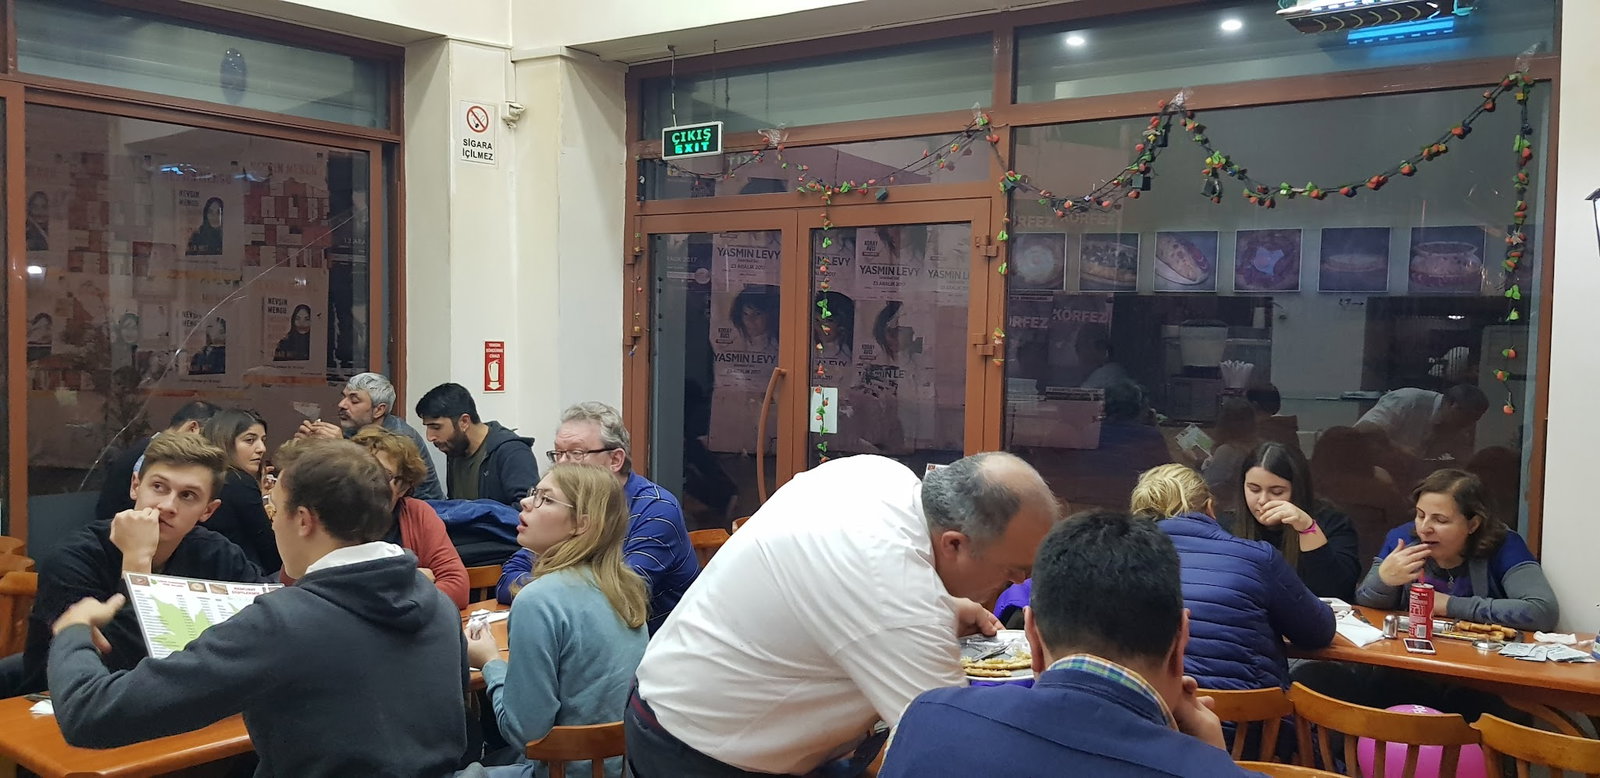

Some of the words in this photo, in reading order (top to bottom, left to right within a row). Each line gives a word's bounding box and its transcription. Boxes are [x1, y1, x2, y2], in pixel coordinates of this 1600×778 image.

[672, 128, 711, 145] ÇIKIŞ
[675, 142, 709, 154] EXIT
[717, 247, 754, 258] YASMIN
[756, 250, 781, 260] LEVY
[860, 265, 894, 276] YASMIN
[896, 266, 920, 277] LEVY
[928, 269, 961, 280] YASMIN
[713, 352, 751, 363] YASMIN
[752, 355, 776, 364] LEVY
